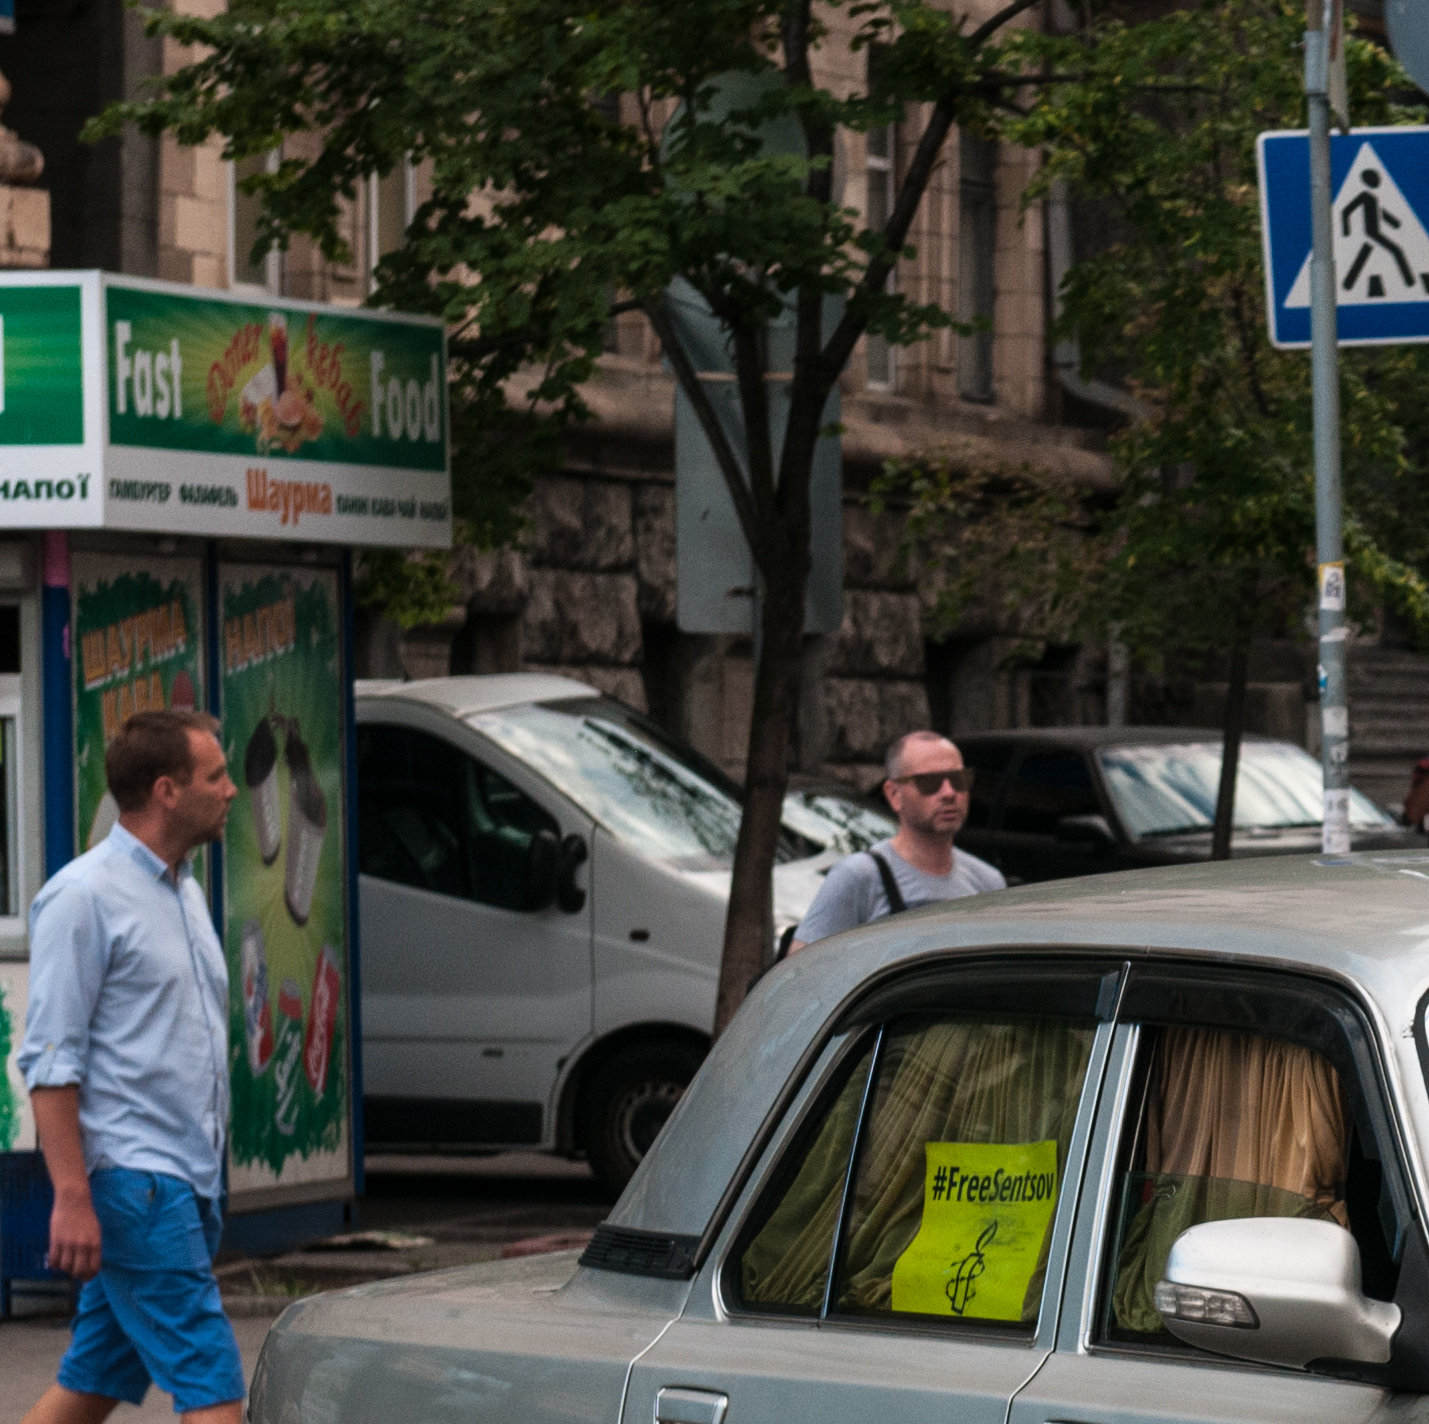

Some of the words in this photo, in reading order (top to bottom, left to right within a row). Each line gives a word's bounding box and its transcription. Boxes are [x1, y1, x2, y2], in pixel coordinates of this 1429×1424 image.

[115, 320, 183, 420] Fast
[371, 350, 441, 442] Food
[245, 467, 332, 526] Шаурма
[932, 1166, 1055, 1202] #FreeSentsov
